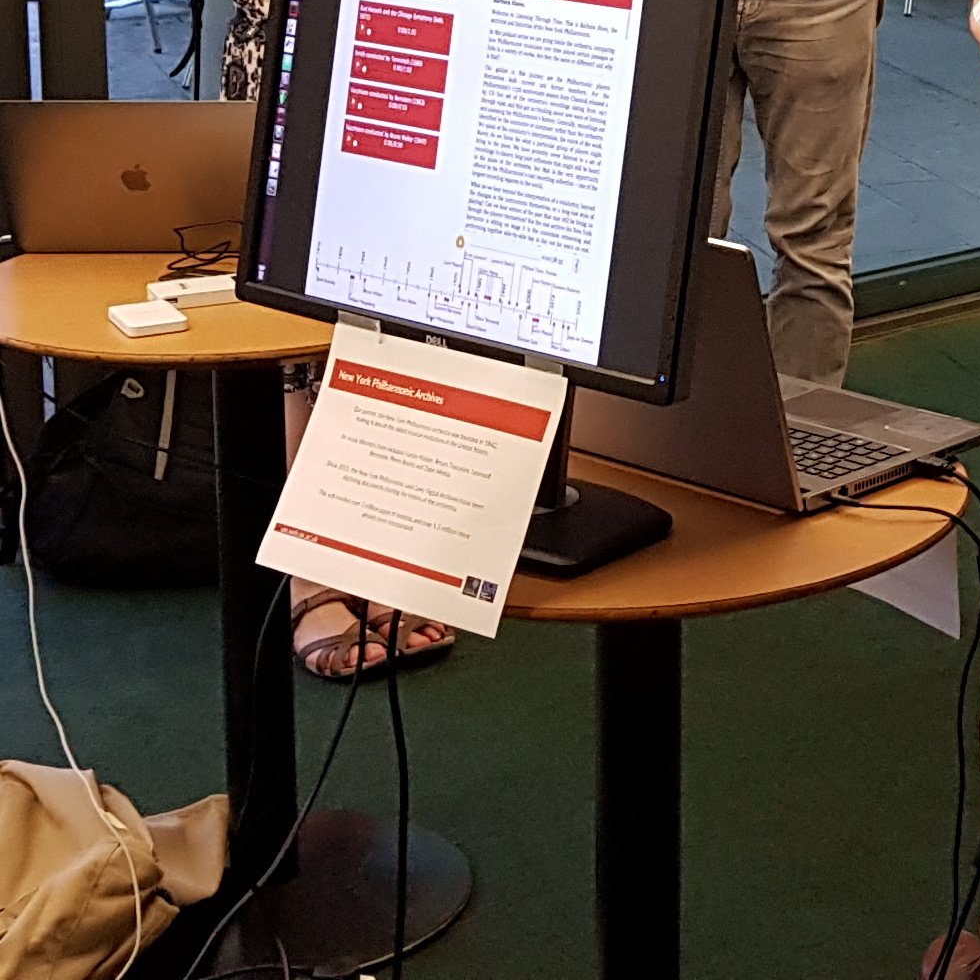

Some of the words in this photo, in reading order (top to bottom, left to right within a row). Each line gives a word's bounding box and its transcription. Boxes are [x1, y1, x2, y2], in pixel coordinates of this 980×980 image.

[425, 335, 448, 349] DELL
[338, 370, 355, 382] New
[355, 374, 372, 386] York
